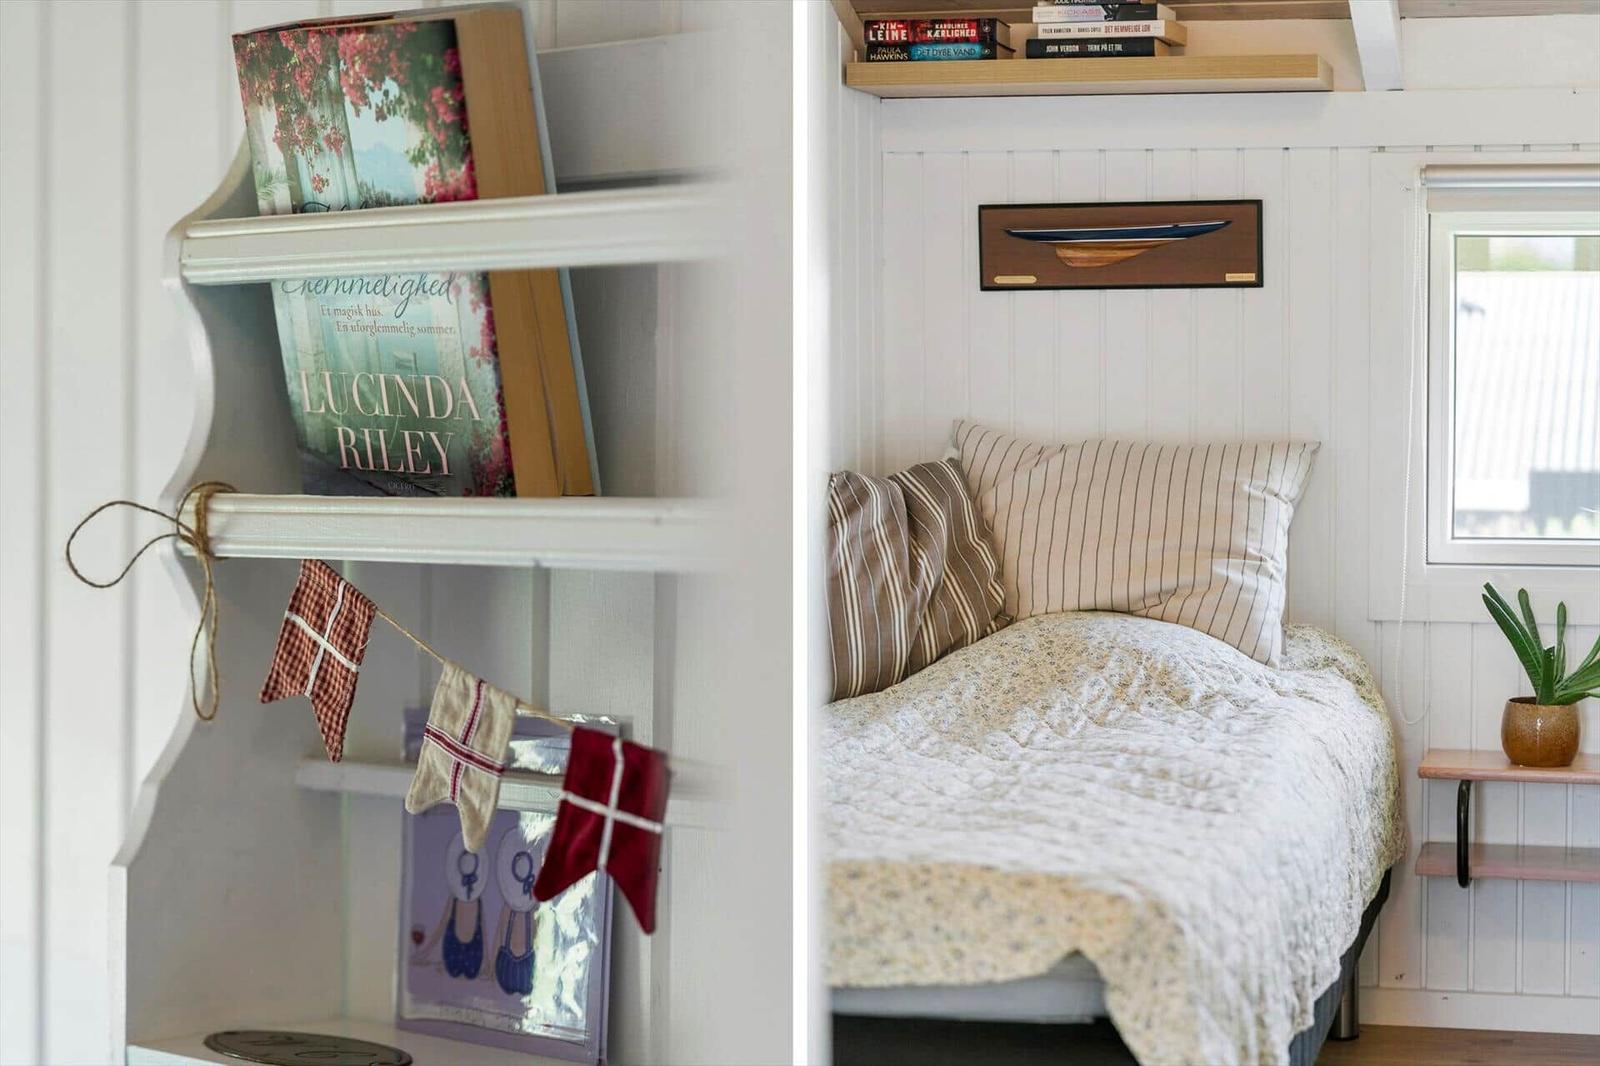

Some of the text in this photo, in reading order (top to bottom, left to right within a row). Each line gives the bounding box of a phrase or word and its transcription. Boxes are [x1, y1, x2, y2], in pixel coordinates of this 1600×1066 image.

[869, 30, 908, 41] LEINE
[927, 28, 976, 38] KÆRLIGHED
[870, 52, 909, 61] HAWKINS
[953, 48, 977, 57] VAND
[320, 304, 384, 320] Et magisk hus.
[336, 320, 456, 339] En uforglemmelig sommer.
[299, 369, 483, 421] LUCINDA
[334, 426, 456, 477] RILEY
